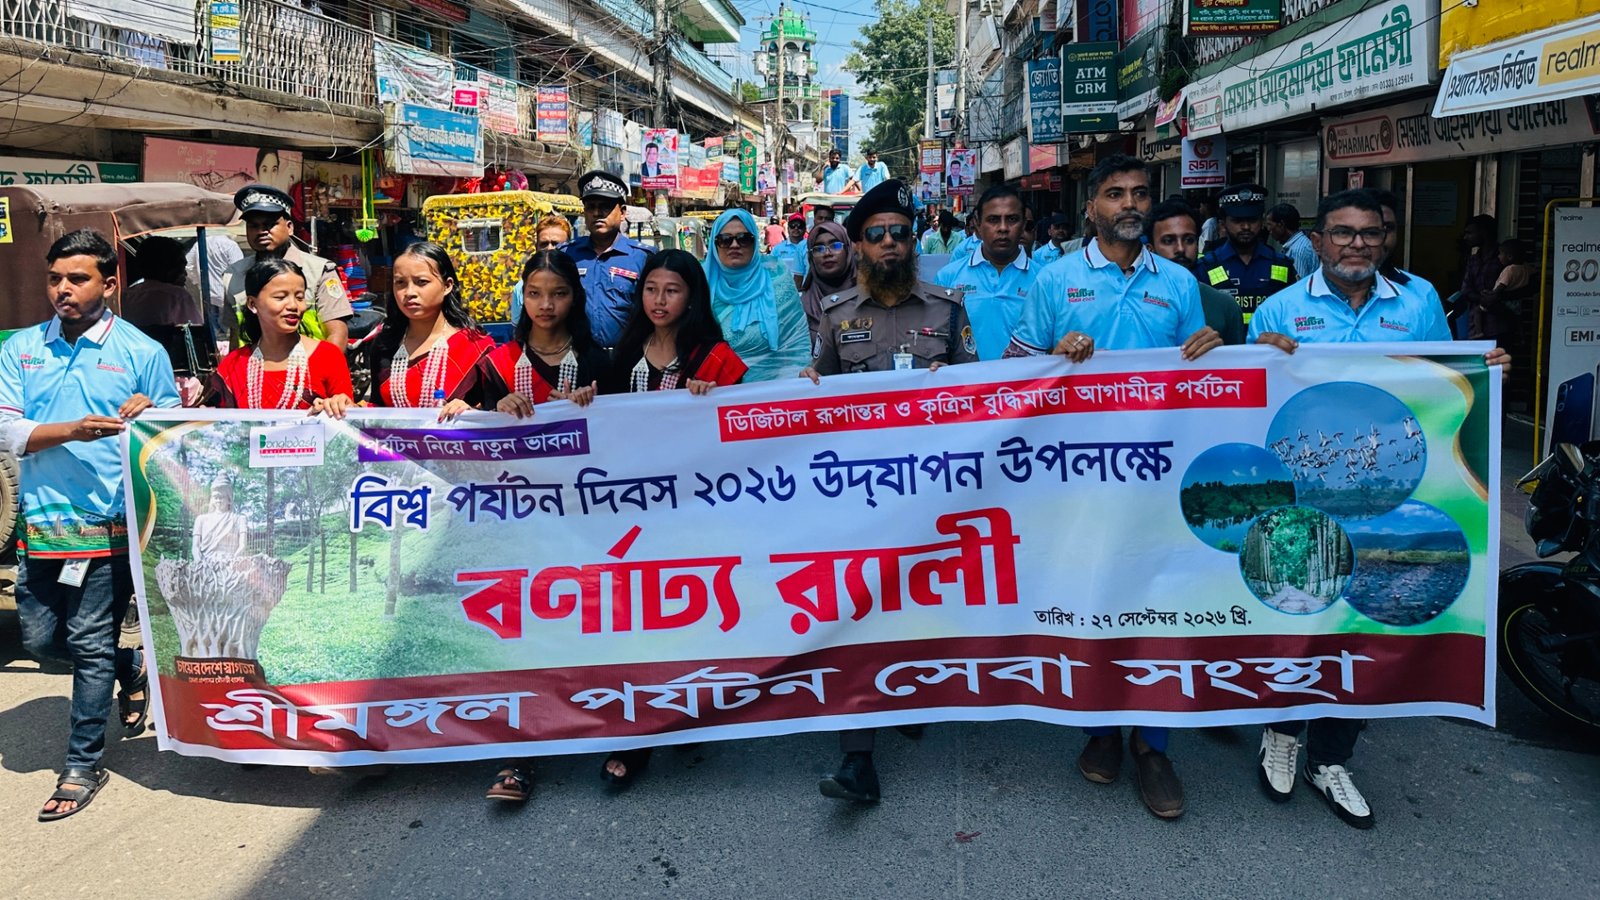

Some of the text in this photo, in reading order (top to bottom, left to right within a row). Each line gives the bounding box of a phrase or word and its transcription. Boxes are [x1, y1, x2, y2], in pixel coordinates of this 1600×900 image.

[1337, 4, 1412, 83] ফার্মেসী
[1546, 40, 1600, 75] realm
[1031, 62, 1058, 87] জ্যোতি
[1076, 67, 1107, 79] ATM
[1447, 50, 1538, 99] এখানে সহজ কিস্তিতে
[1075, 82, 1107, 94] CRM
[1338, 134, 1380, 154] PHARMACY
[1188, 159, 1219, 171] নগদ
[1235, 296, 1254, 308] RIST
[1570, 331, 1594, 342] EMI
[724, 409, 809, 433] ডিজিটাল
[814, 402, 888, 425] রূপান্তর
[895, 402, 911, 417] ও
[917, 392, 976, 424] কৃত্রিম
[1073, 376, 1168, 405] আগামীর
[1175, 373, 1244, 400] পর্যটন
[364, 429, 583, 459] পর্যটন নিয়ে নতুন ভাবনা
[350, 475, 431, 529] বিশ্ব
[447, 471, 565, 522] পর্যটন
[574, 467, 678, 515] দিবস
[694, 465, 796, 507] ২০২৬
[997, 436, 1173, 483] উপলক্ষে
[457, 525, 742, 639] বর্ণাঢ্য
[1034, 606, 1075, 626] তারিখ
[1092, 613, 1112, 630] ২৭
[1118, 607, 1178, 626] সেপ্টেম্বর
[1184, 610, 1226, 628] ২০২৬
[1230, 604, 1252, 626] খ্রি.
[200, 661, 223, 675] দেশে
[200, 649, 1375, 741] শ্রীমঙ্গল পর্যটন সেবা সংস্থা
